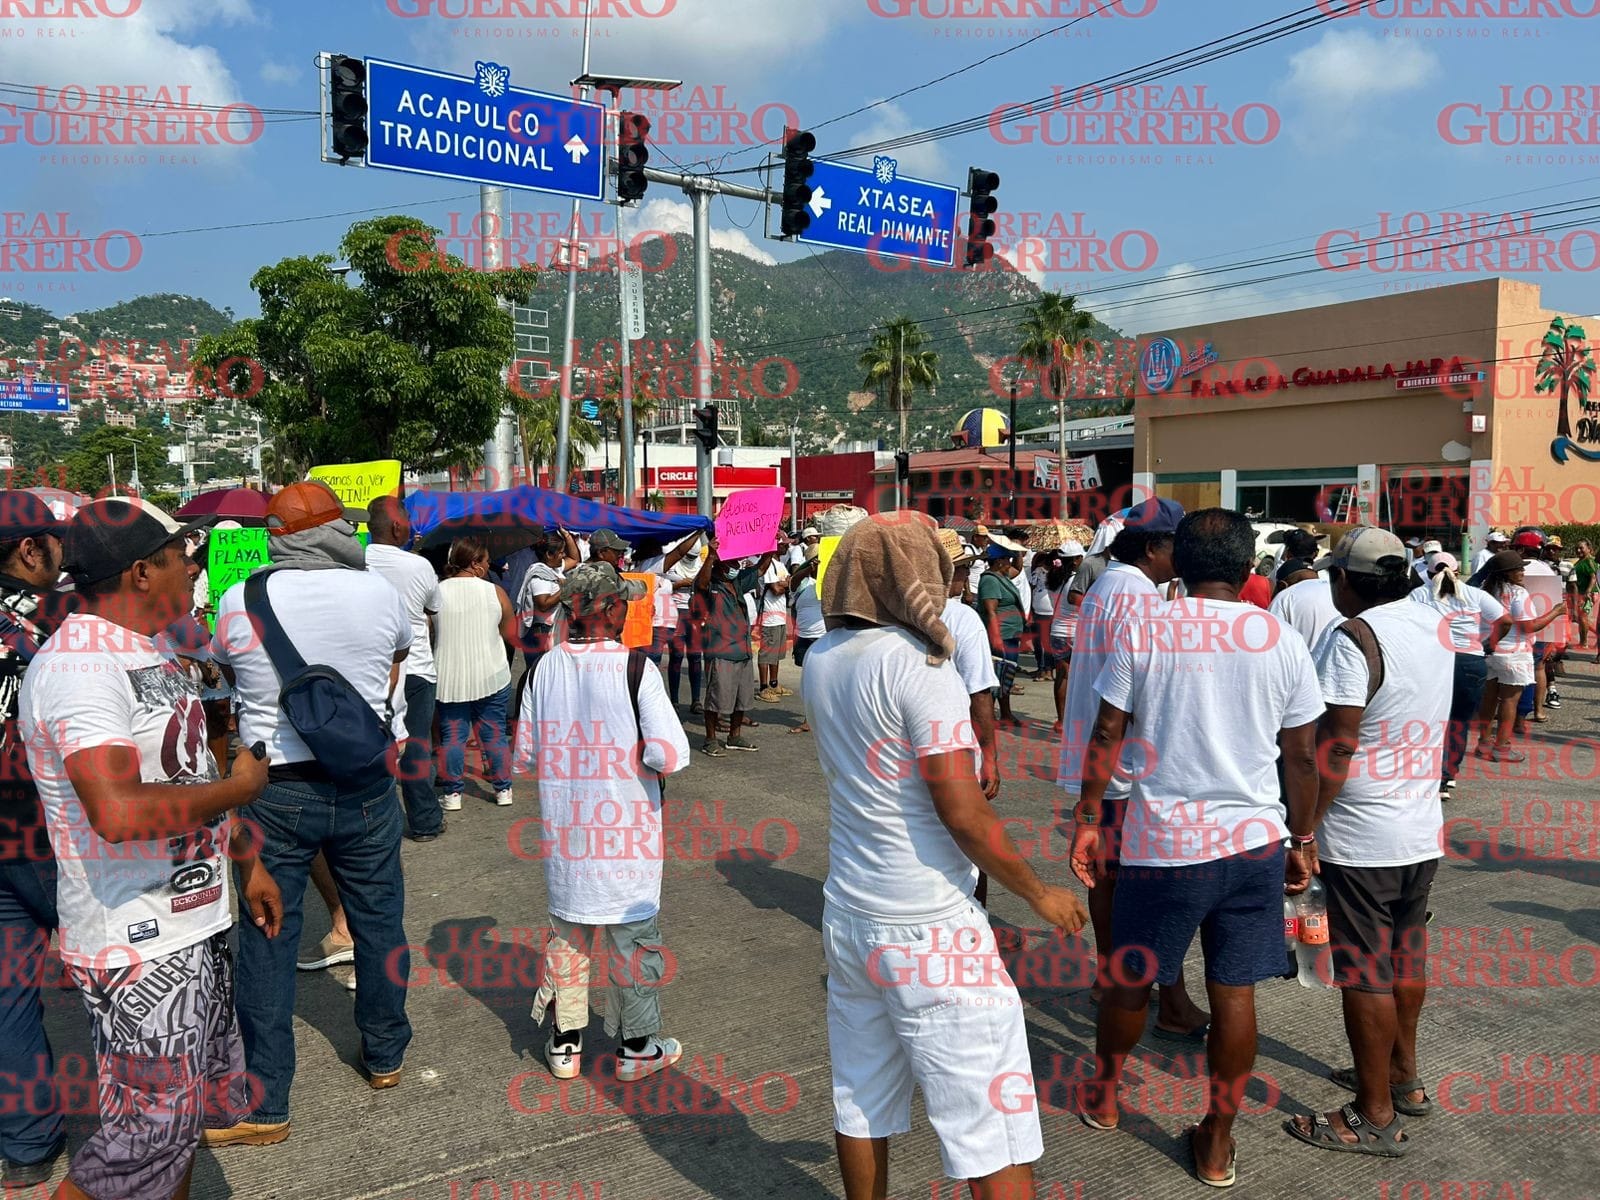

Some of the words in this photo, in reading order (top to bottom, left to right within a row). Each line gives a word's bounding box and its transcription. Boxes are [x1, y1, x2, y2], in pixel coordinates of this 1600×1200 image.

[397, 89, 540, 136] ACAPULCO
[379, 120, 554, 172] TRADICIONAL
[857, 186, 936, 219] XTASEA
[838, 211, 875, 236] REAL
[881, 218, 950, 249] DIAMANTE
[1191, 376, 1288, 398] FARMACIA
[1292, 356, 1464, 387] GUADALAJARA
[1402, 376, 1430, 387] ABIERTO
[1449, 374, 1472, 383] NOCHE
[578, 480, 600, 492] Steren
[660, 472, 694, 480] CIRCLE
[1036, 477, 1098, 490] ABIRTO
[214, 548, 262, 565] PLAYA
